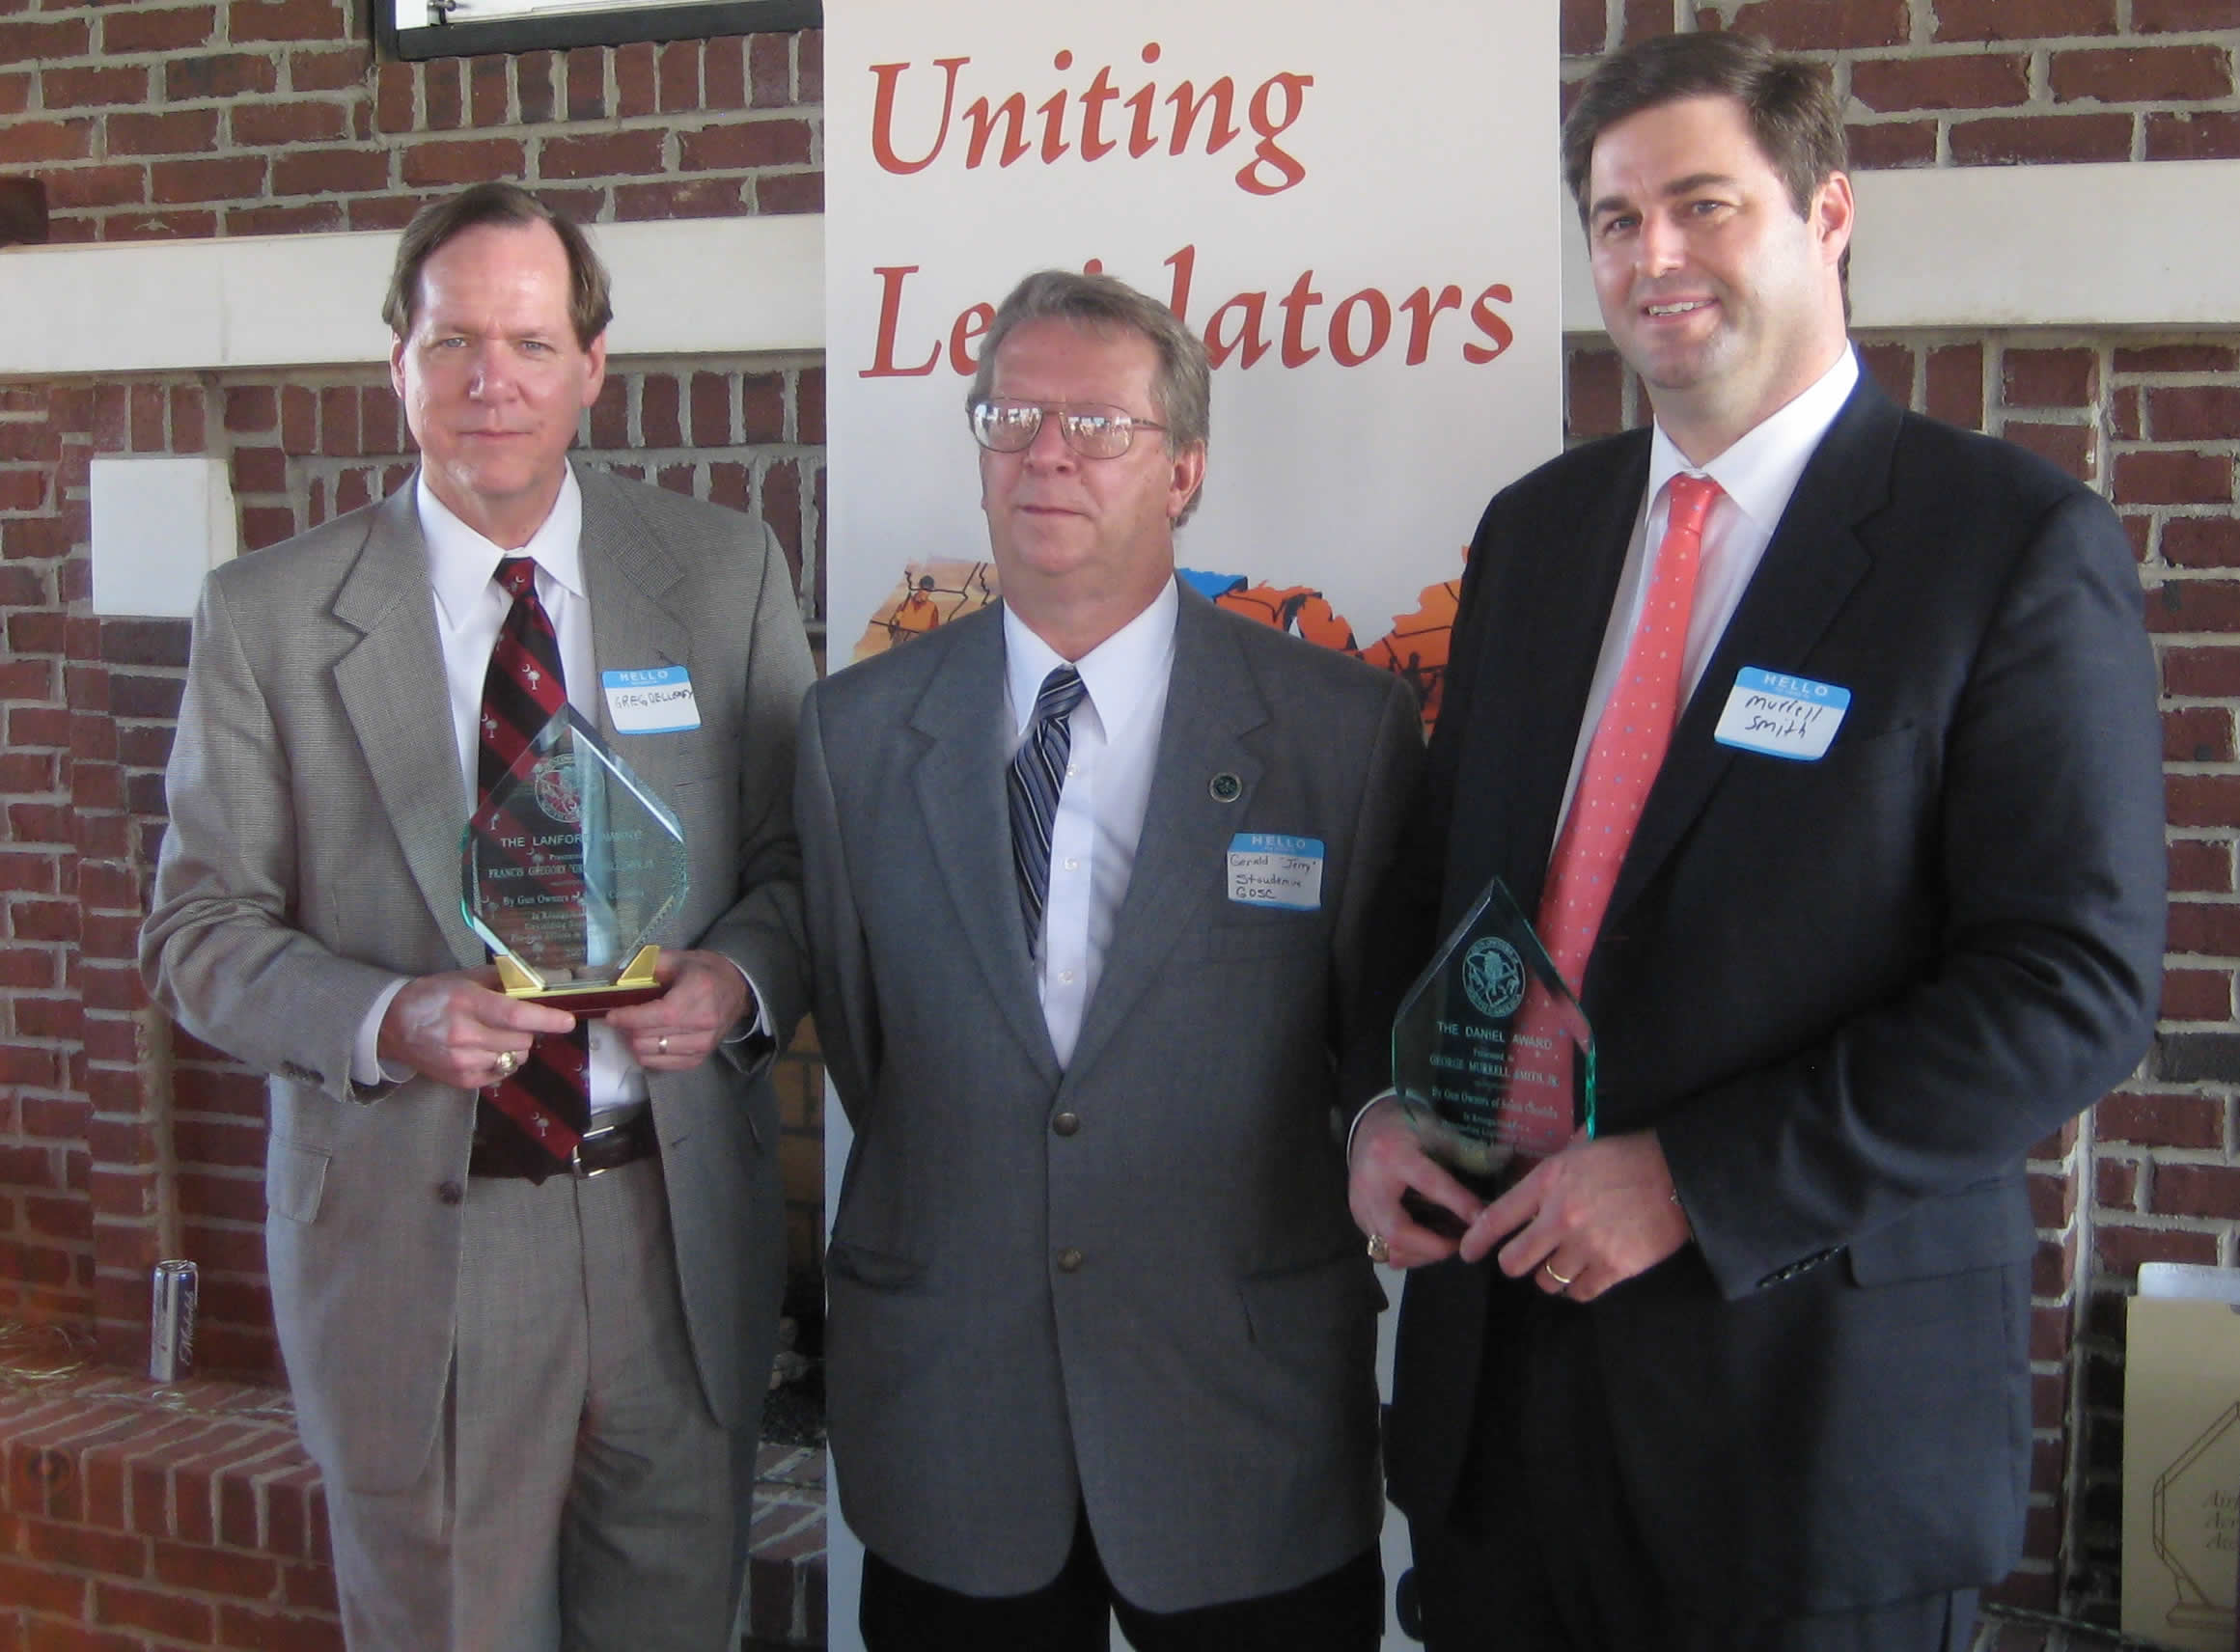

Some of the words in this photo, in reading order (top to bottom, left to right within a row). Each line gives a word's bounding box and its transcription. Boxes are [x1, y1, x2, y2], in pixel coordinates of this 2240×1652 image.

[870, 42, 1314, 195] Uniting
[859, 244, 1512, 377] Lelators
[620, 670, 669, 682] HELLO
[1764, 674, 1828, 696] HELLO
[1745, 715, 1807, 738] Smith
[500, 837, 525, 847] THE
[1252, 835, 1306, 848] HELLO
[1437, 1021, 1459, 1035] THE
[1465, 1026, 1506, 1043] DANIEL
